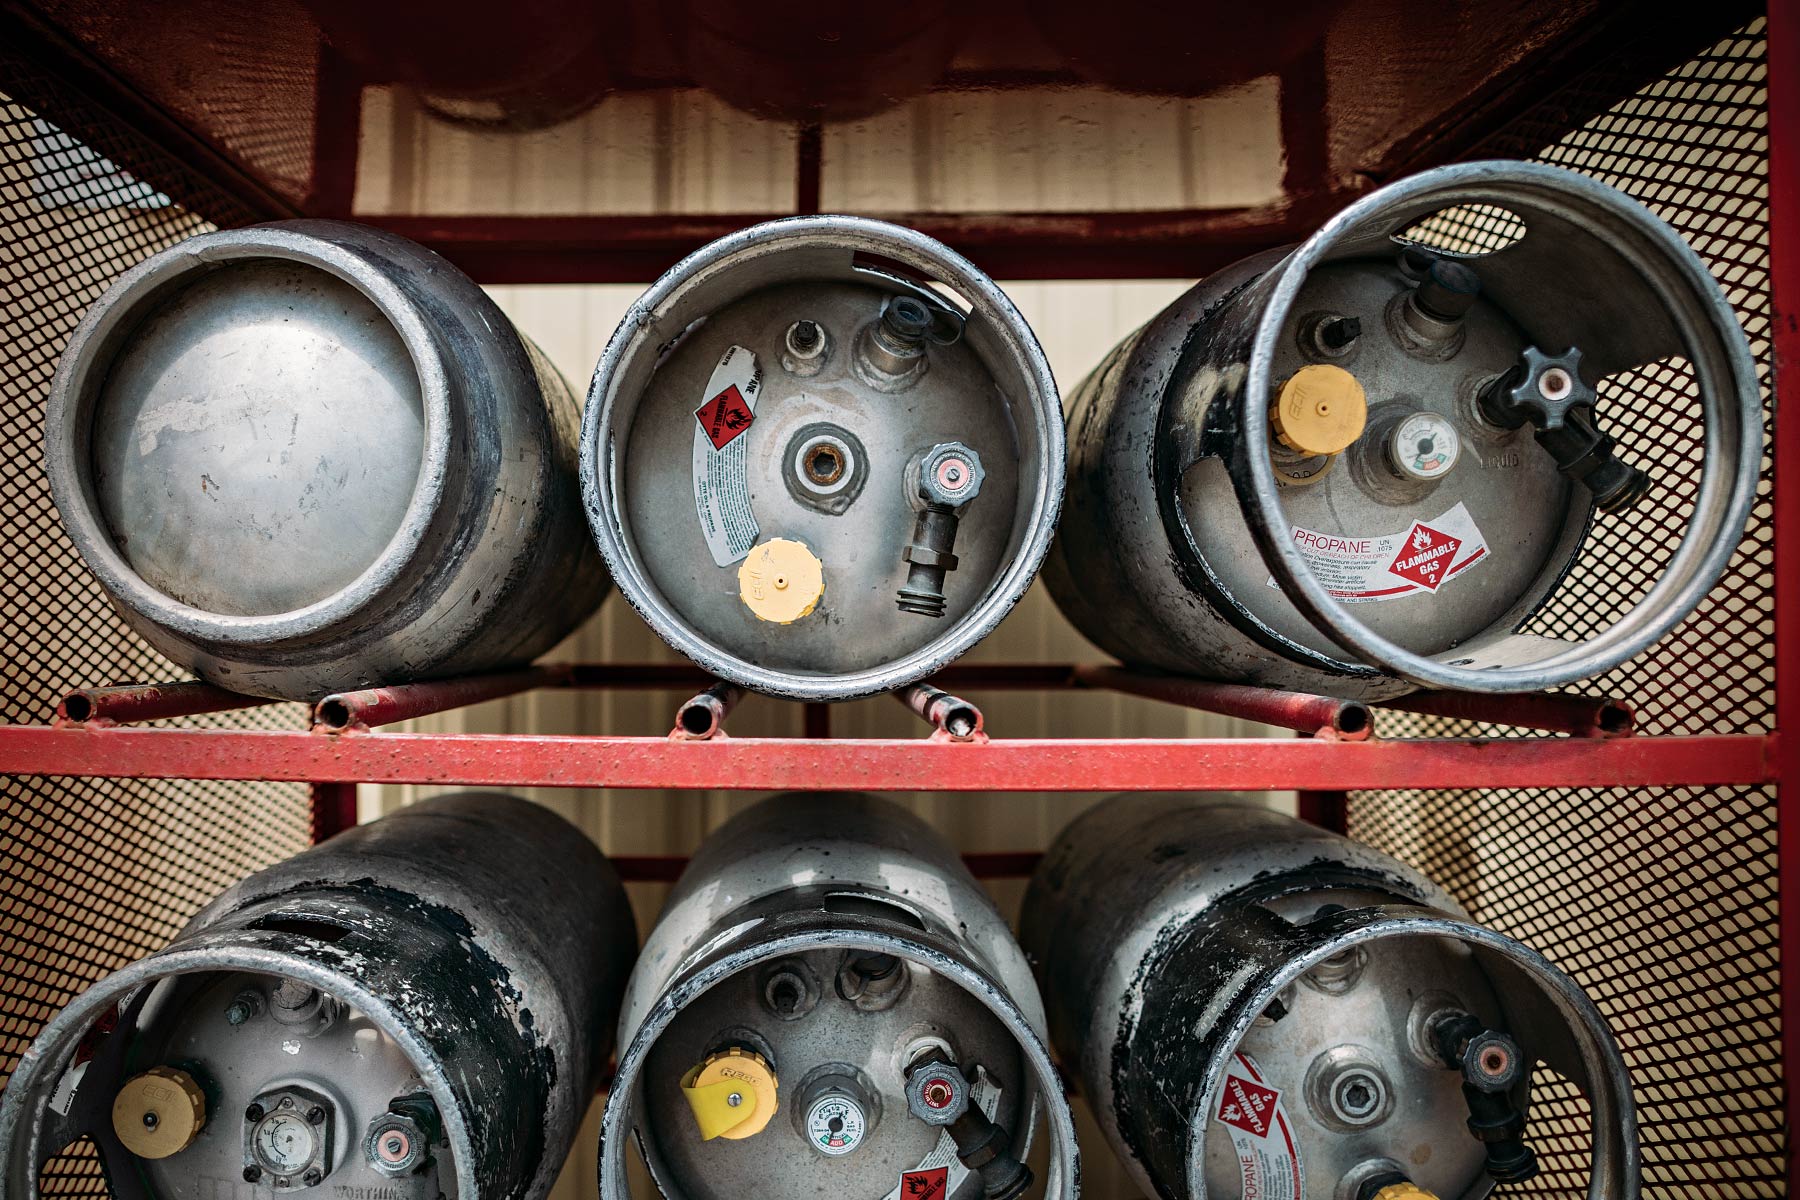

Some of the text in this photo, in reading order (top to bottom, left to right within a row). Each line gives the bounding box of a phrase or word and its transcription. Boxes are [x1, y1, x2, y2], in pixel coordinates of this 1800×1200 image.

[713, 395, 729, 427] FLAMMABLE
[1293, 529, 1371, 553] PROPANE
[1395, 540, 1456, 572] FLAMMABLE
[1419, 560, 1440, 575] GAS
[1428, 573, 1437, 584] 2
[1229, 1079, 1265, 1133] FLAMMABLE
[1249, 1092, 1265, 1112] GAS
[1262, 1093, 1273, 1102] 2
[1241, 1155, 1256, 1200] ROPANE
[333, 1185, 403, 1200] WORTHIN
